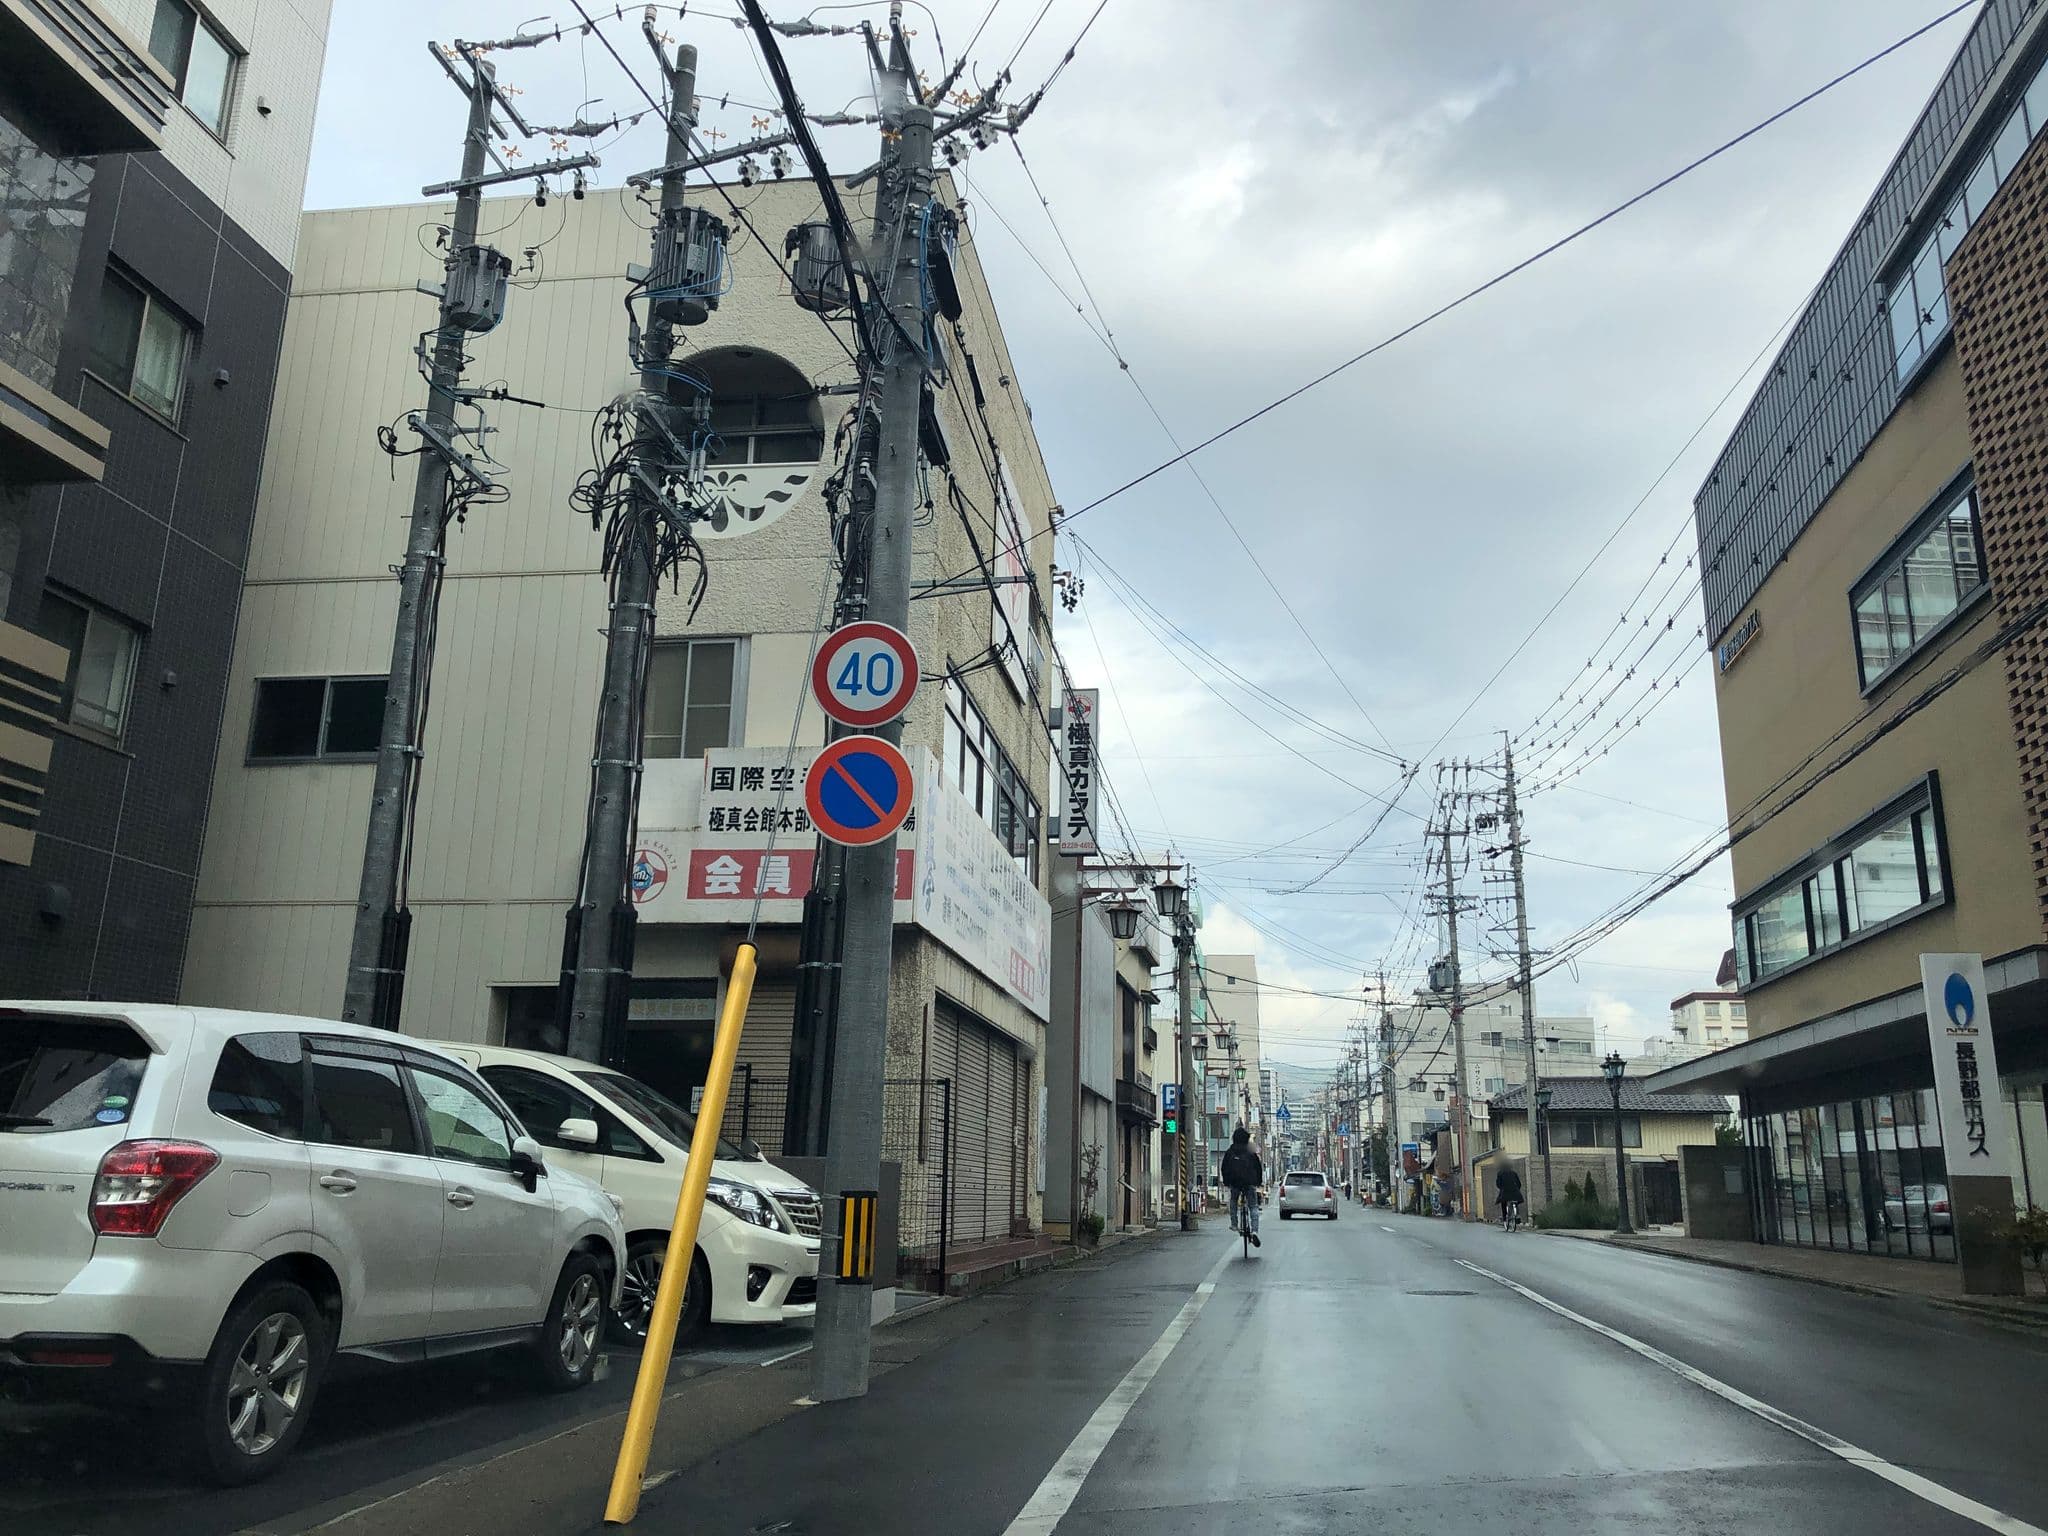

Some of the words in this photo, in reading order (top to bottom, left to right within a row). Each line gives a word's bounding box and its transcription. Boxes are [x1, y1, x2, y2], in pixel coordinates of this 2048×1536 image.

[836, 652, 894, 696] 40
[709, 807, 817, 833] 極真会館本部
[1067, 723, 1090, 838] 極真カラテ
[1955, 1042, 1989, 1157] 長野都市ガス
